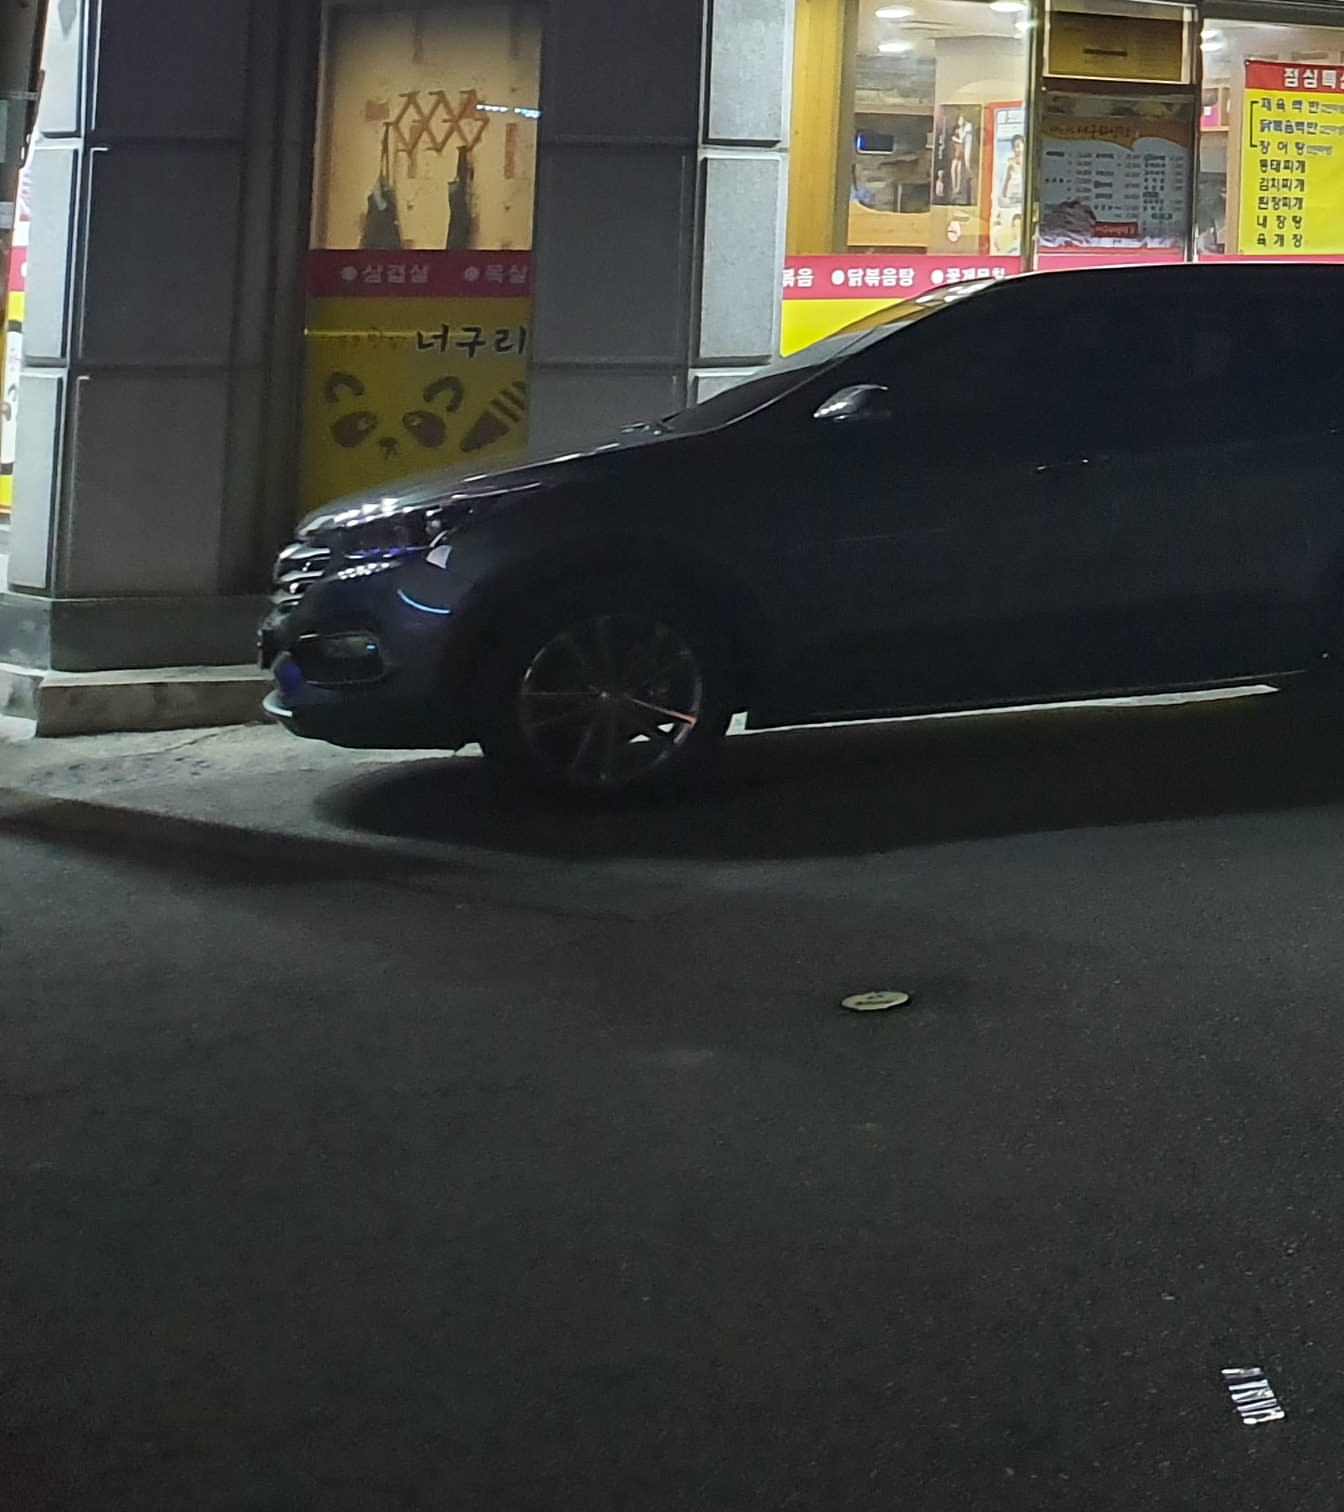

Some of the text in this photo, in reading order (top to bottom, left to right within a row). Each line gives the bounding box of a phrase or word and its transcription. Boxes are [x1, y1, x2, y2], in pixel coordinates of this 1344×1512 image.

[1258, 177, 1306, 193] 김치찌개
[1257, 196, 1304, 211] 된장찌개
[847, 267, 915, 287] 닭볶음탕
[416, 322, 527, 359] 너구리
